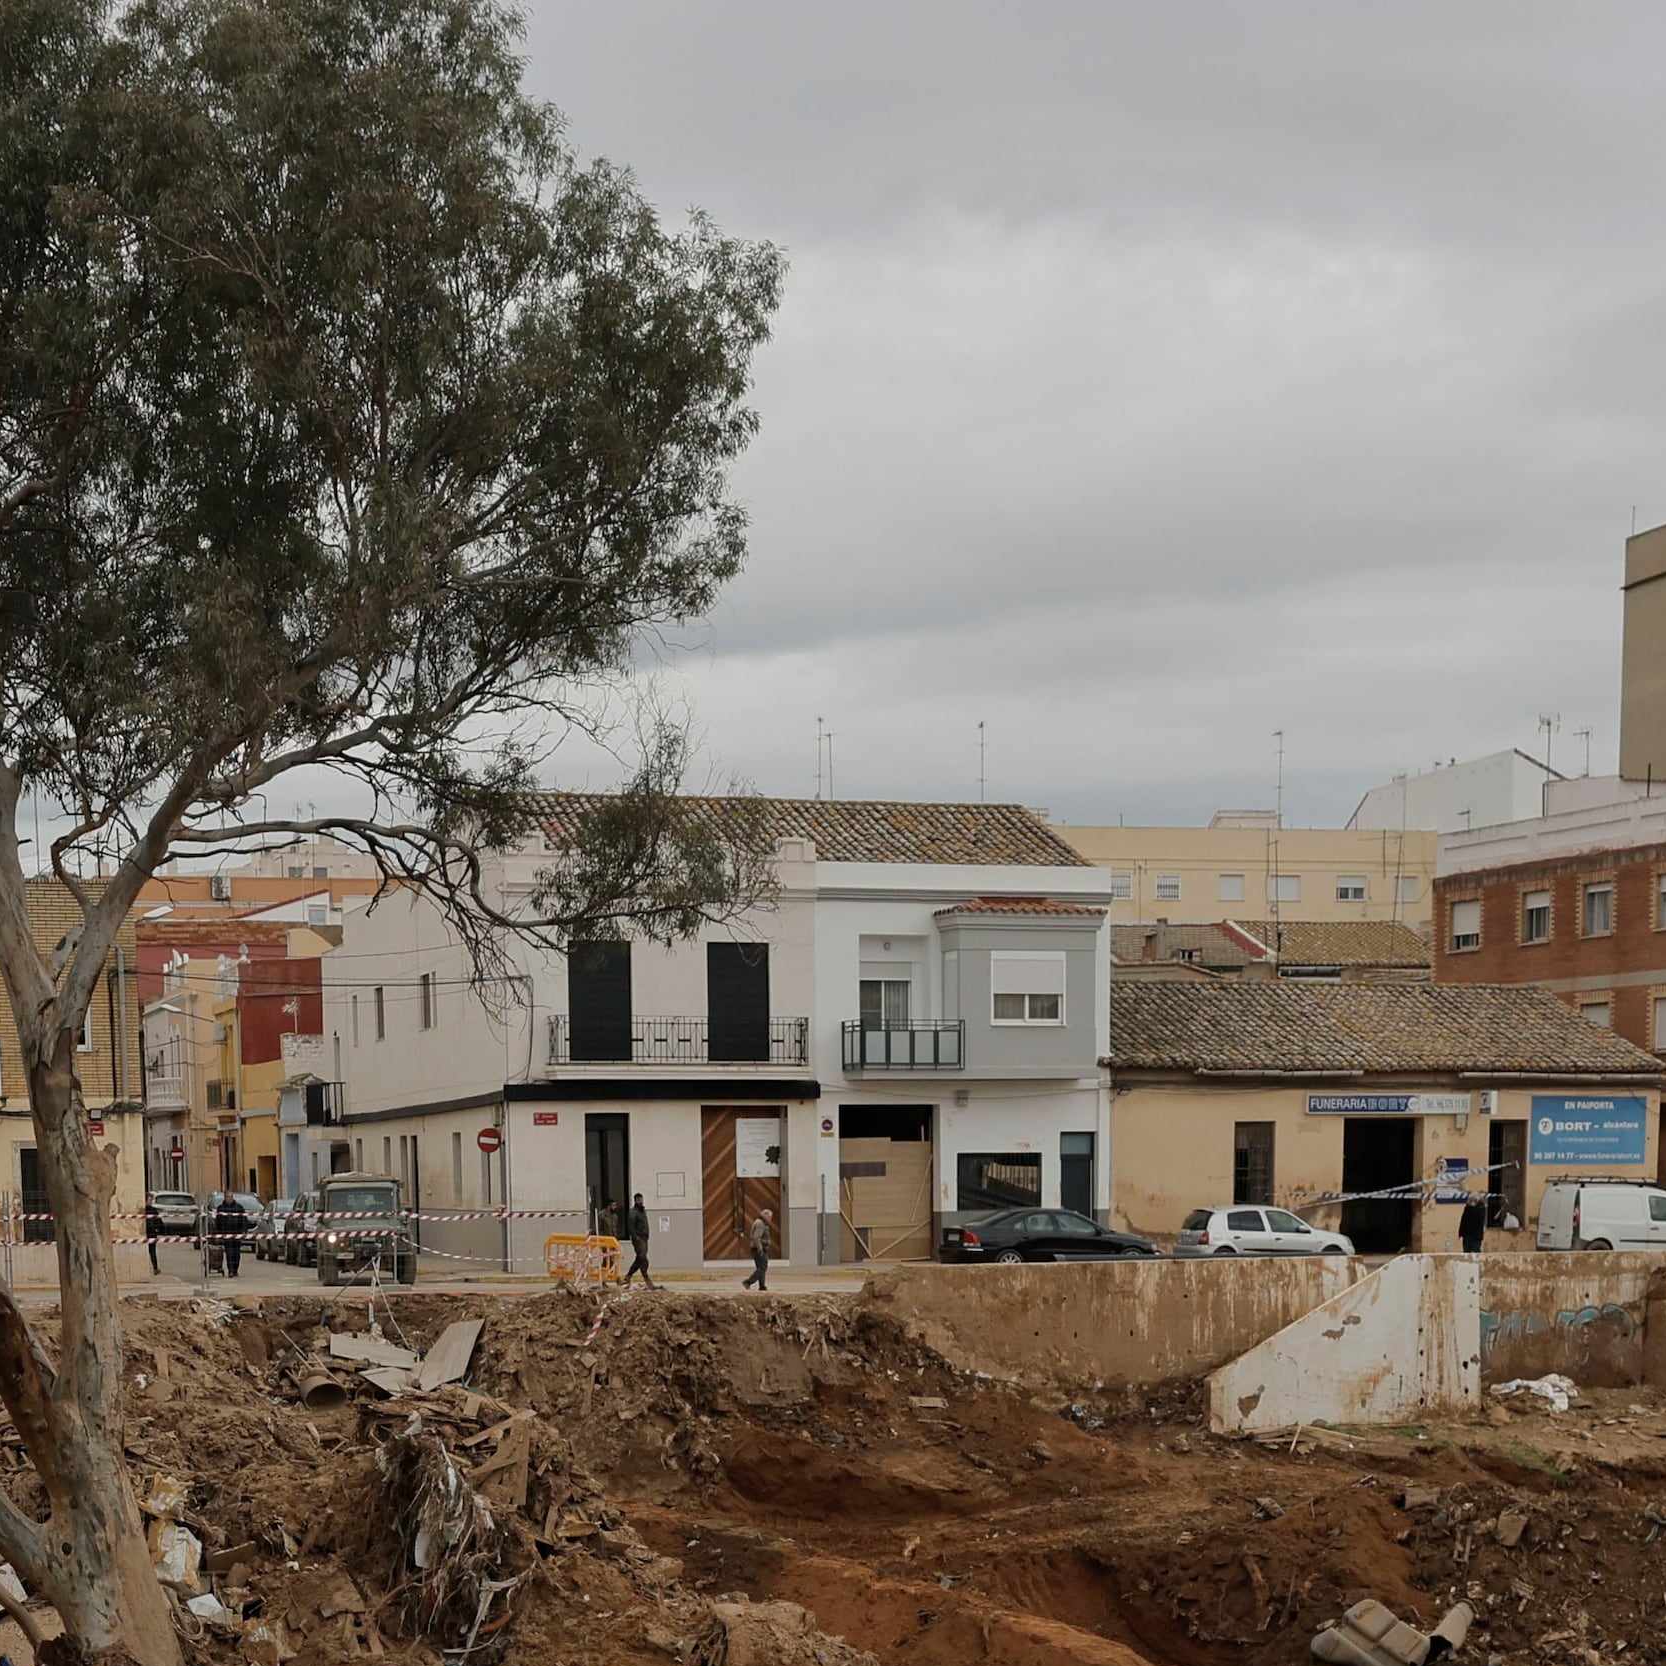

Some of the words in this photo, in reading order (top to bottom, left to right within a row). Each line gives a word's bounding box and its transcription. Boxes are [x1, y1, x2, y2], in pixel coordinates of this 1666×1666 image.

[1310, 1097, 1367, 1110] FUNERARIA
[1367, 1098, 1407, 1110] BORT
[1564, 1101, 1575, 1109] EN
[1577, 1101, 1614, 1109] PAIPORTA
[1555, 1121, 1592, 1131] BORT
[1566, 1151, 1574, 1160] 77
